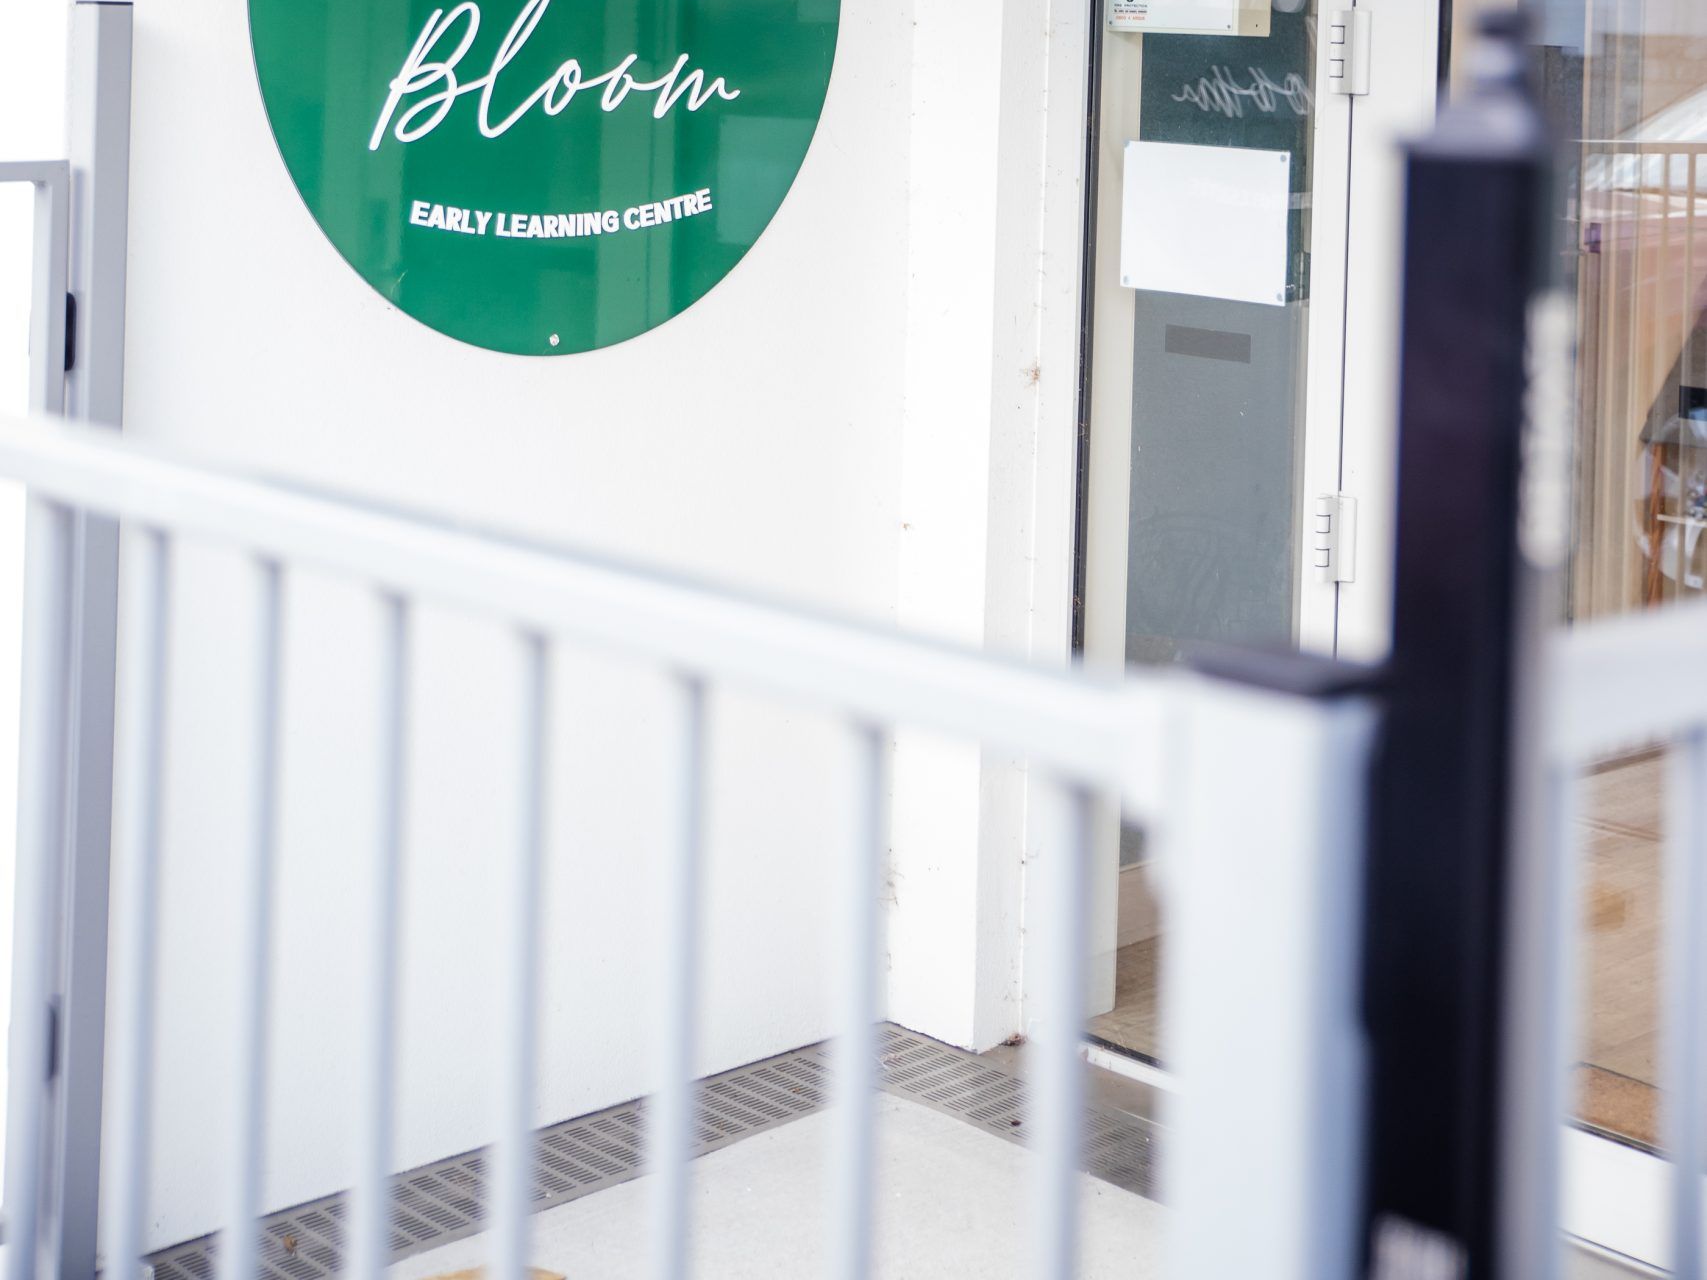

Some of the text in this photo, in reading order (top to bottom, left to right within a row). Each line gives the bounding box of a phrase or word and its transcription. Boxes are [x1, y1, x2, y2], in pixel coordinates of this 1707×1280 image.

[409, 188, 713, 238] EARLY LEARNING CENTRE
